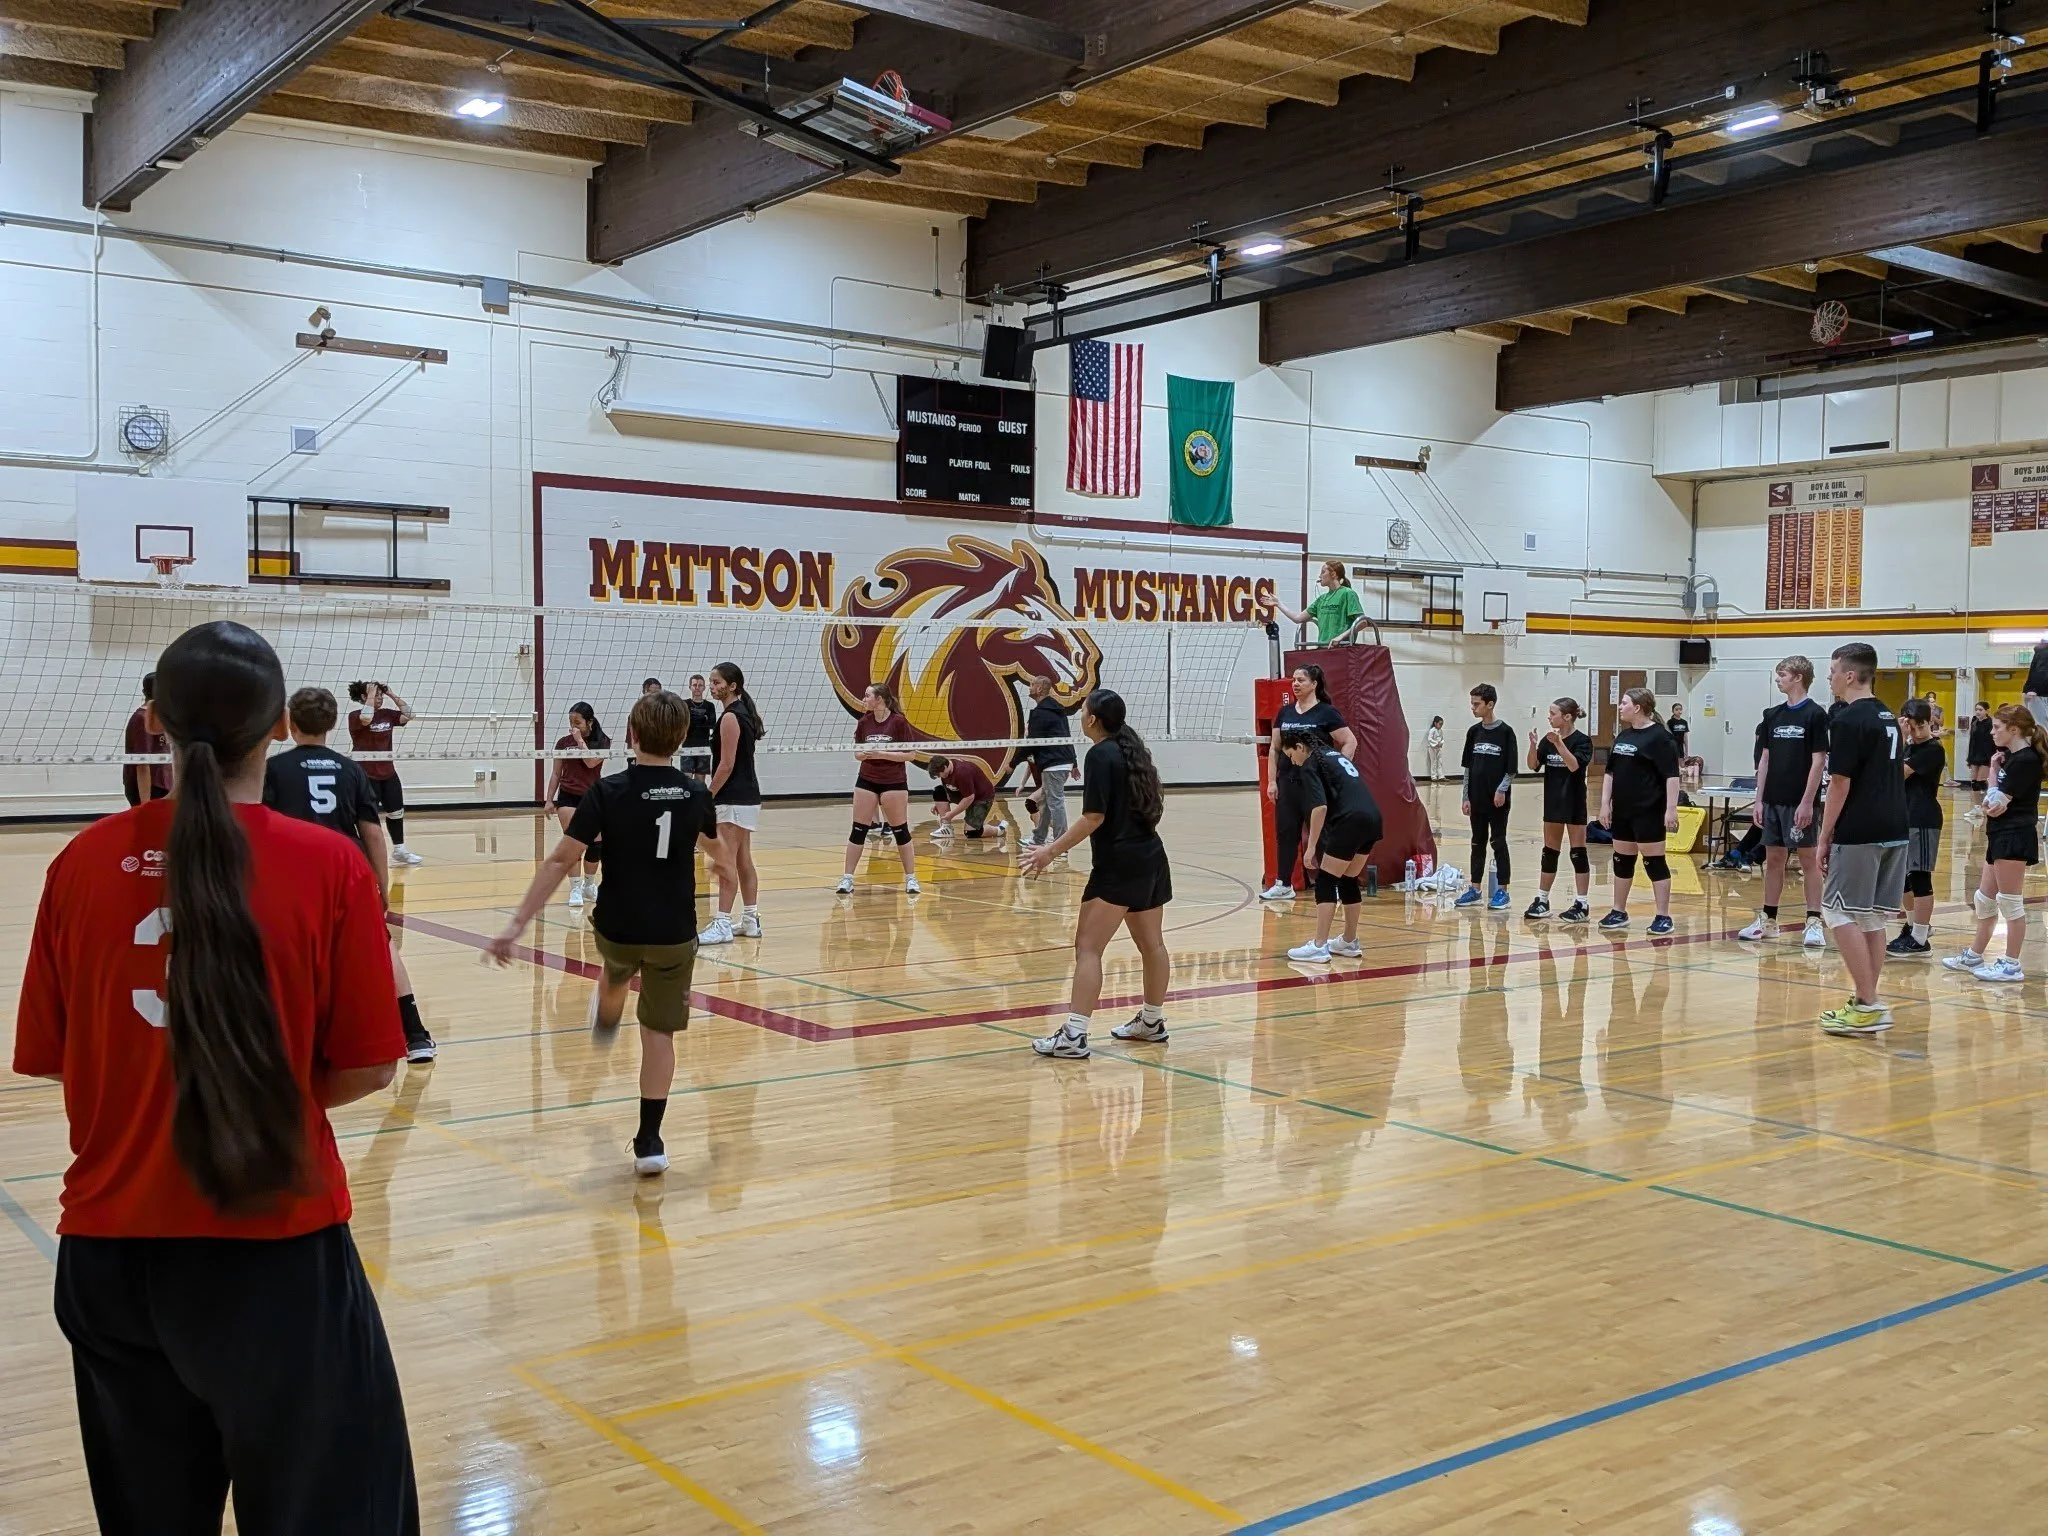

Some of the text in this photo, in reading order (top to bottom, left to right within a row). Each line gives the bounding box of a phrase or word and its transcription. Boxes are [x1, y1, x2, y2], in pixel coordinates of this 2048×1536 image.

[907, 410, 956, 427] MUSTANGS
[958, 423, 981, 433] PERIOD
[998, 421, 1028, 435] GUEST
[906, 454, 927, 464] FOULS
[949, 458, 991, 470] PLAYER FOUL
[1011, 465, 1030, 474] FOULS
[1811, 483, 1824, 491] BOY
[1832, 481, 1846, 489] GIRL
[906, 488, 927, 498] SCORE
[959, 493, 980, 502] MATCH
[1818, 492, 1829, 500] THE
[1832, 491, 1847, 499] YEAR
[1011, 497, 1030, 507] SCORE
[589, 537, 835, 612] MATTSON
[1074, 567, 1277, 624] MUSTANGS
[1886, 726, 1898, 759] 7
[1338, 758, 1359, 777] 8
[308, 776, 337, 813] 5
[656, 811, 672, 859] 1
